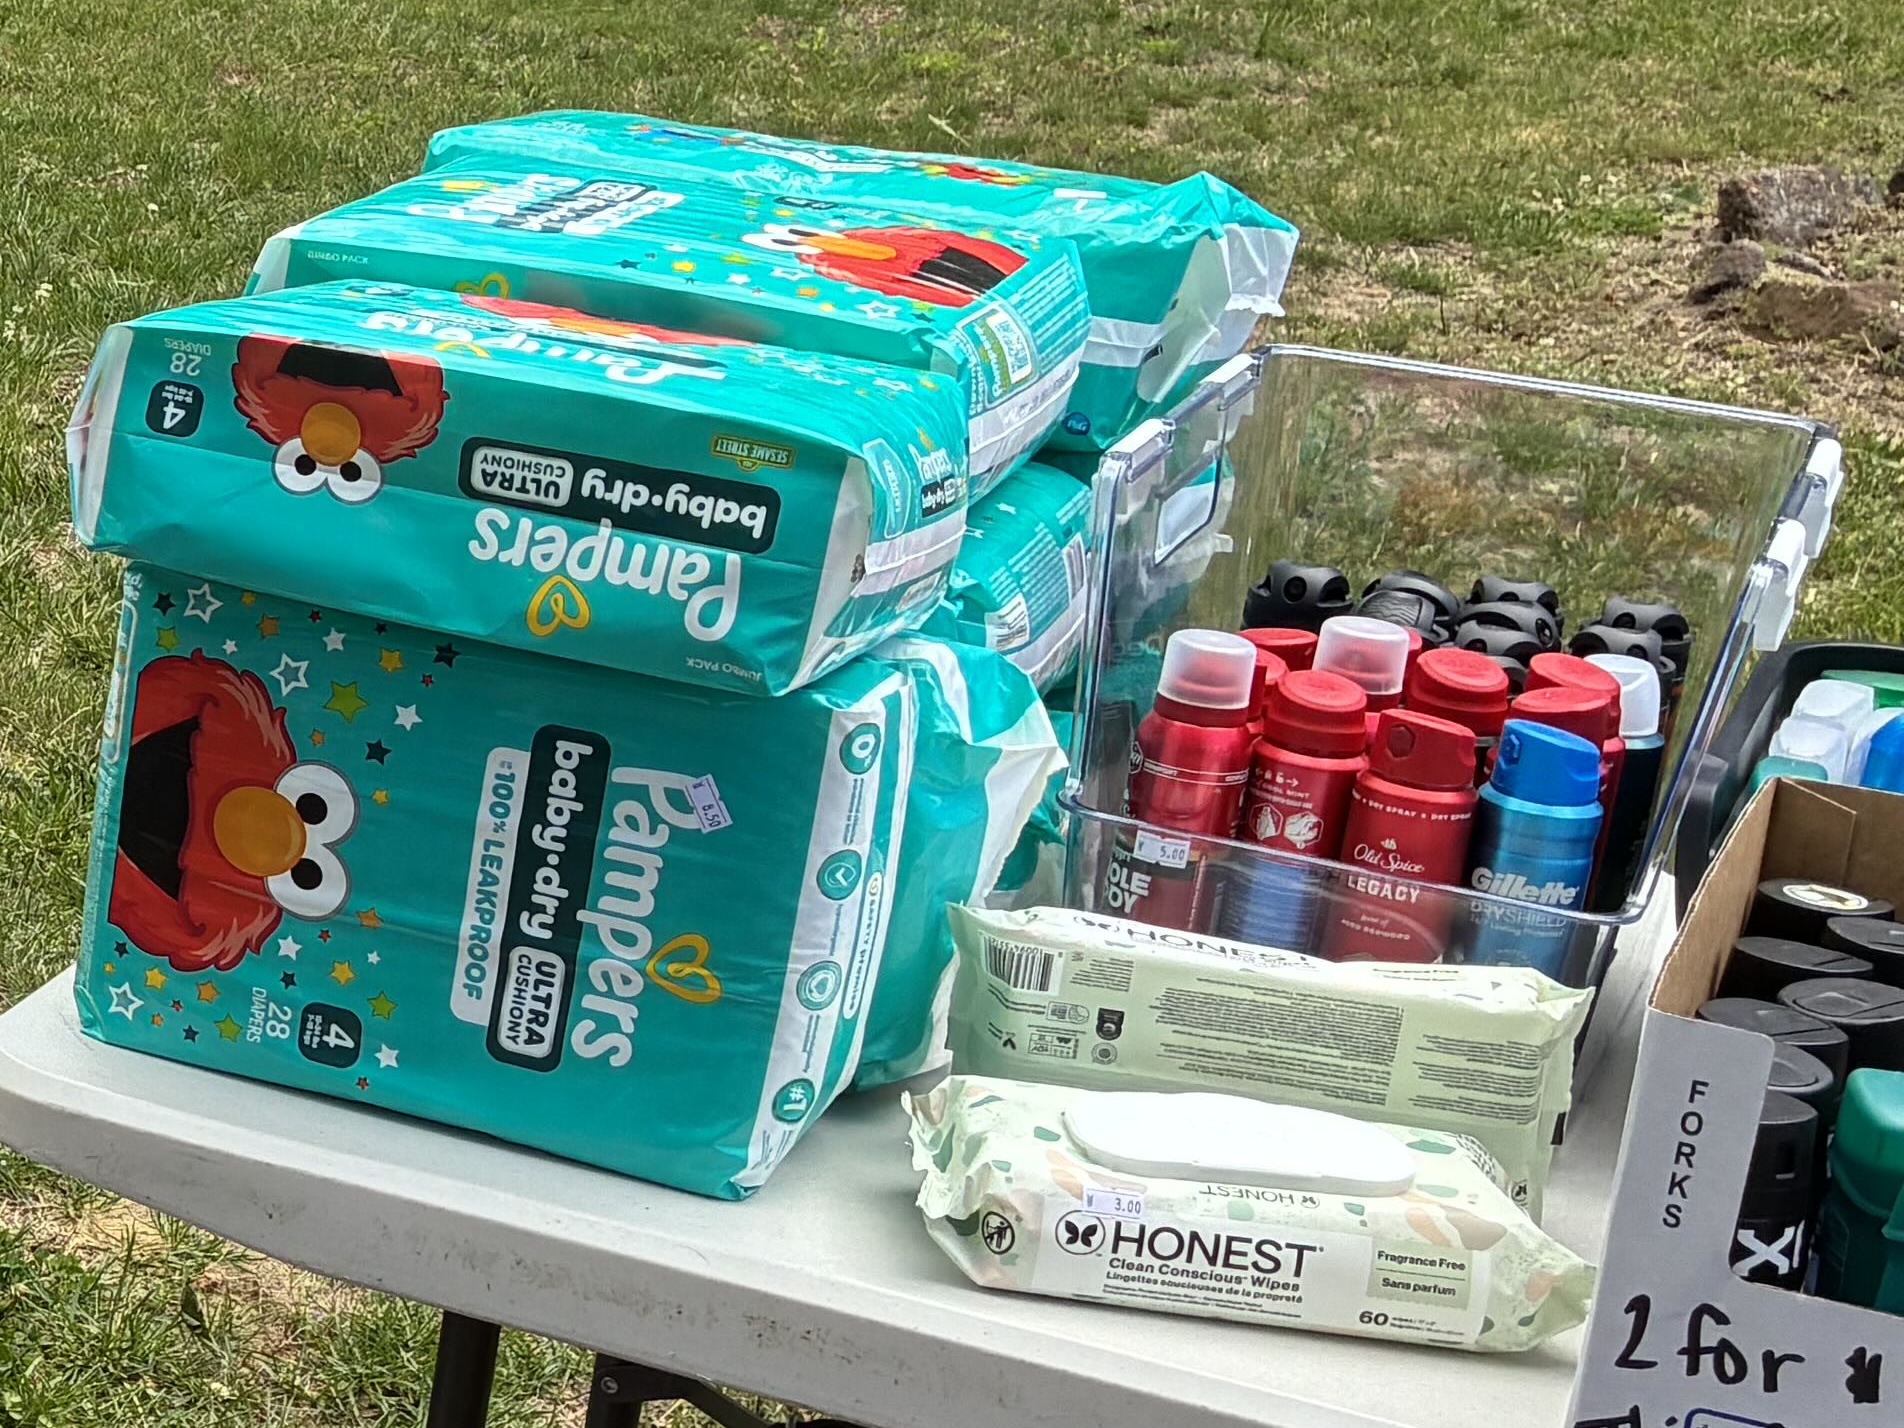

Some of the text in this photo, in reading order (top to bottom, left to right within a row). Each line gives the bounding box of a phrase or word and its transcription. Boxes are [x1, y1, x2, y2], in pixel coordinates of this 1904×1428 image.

[163, 338, 212, 356] DIAPERS
[170, 352, 203, 376] 28
[162, 401, 187, 430] 4
[714, 437, 789, 463] SESAME STREET
[480, 452, 567, 479] CUSHIONY
[480, 468, 561, 501] ULTRA
[468, 507, 742, 642] Pampers
[685, 656, 763, 682] JUMBO PACK
[1386, 804, 1418, 818] SPRAY
[1159, 844, 1186, 862] 5.00
[1354, 843, 1425, 873] Old Spice
[464, 766, 517, 1002] 100% LEAKPROOF
[1347, 875, 1421, 904] LEGACY
[1472, 866, 1577, 906] Gillette
[571, 766, 699, 1069] Pampers
[505, 953, 533, 1047] CUSHIONY
[524, 960, 561, 1050] ULTRA
[246, 987, 267, 1044] DIAPERS
[266, 1002, 292, 1039] 28
[322, 1023, 355, 1049] 4
[1662, 1079, 1709, 1229] FORKS
[1113, 1197, 1143, 1216] 3.00
[1199, 1183, 1296, 1206] HONEST
[1110, 1220, 1317, 1279] HONEST
[1376, 1249, 1467, 1272] Fragrance Free
[1106, 1270, 1159, 1288] Lingettes
[1108, 1256, 1301, 1294] Clean Conscious Wipes
[1381, 1276, 1458, 1299] Sans parfum
[1358, 1310, 1390, 1328] 60
[1614, 1294, 1806, 1394] 2 for
